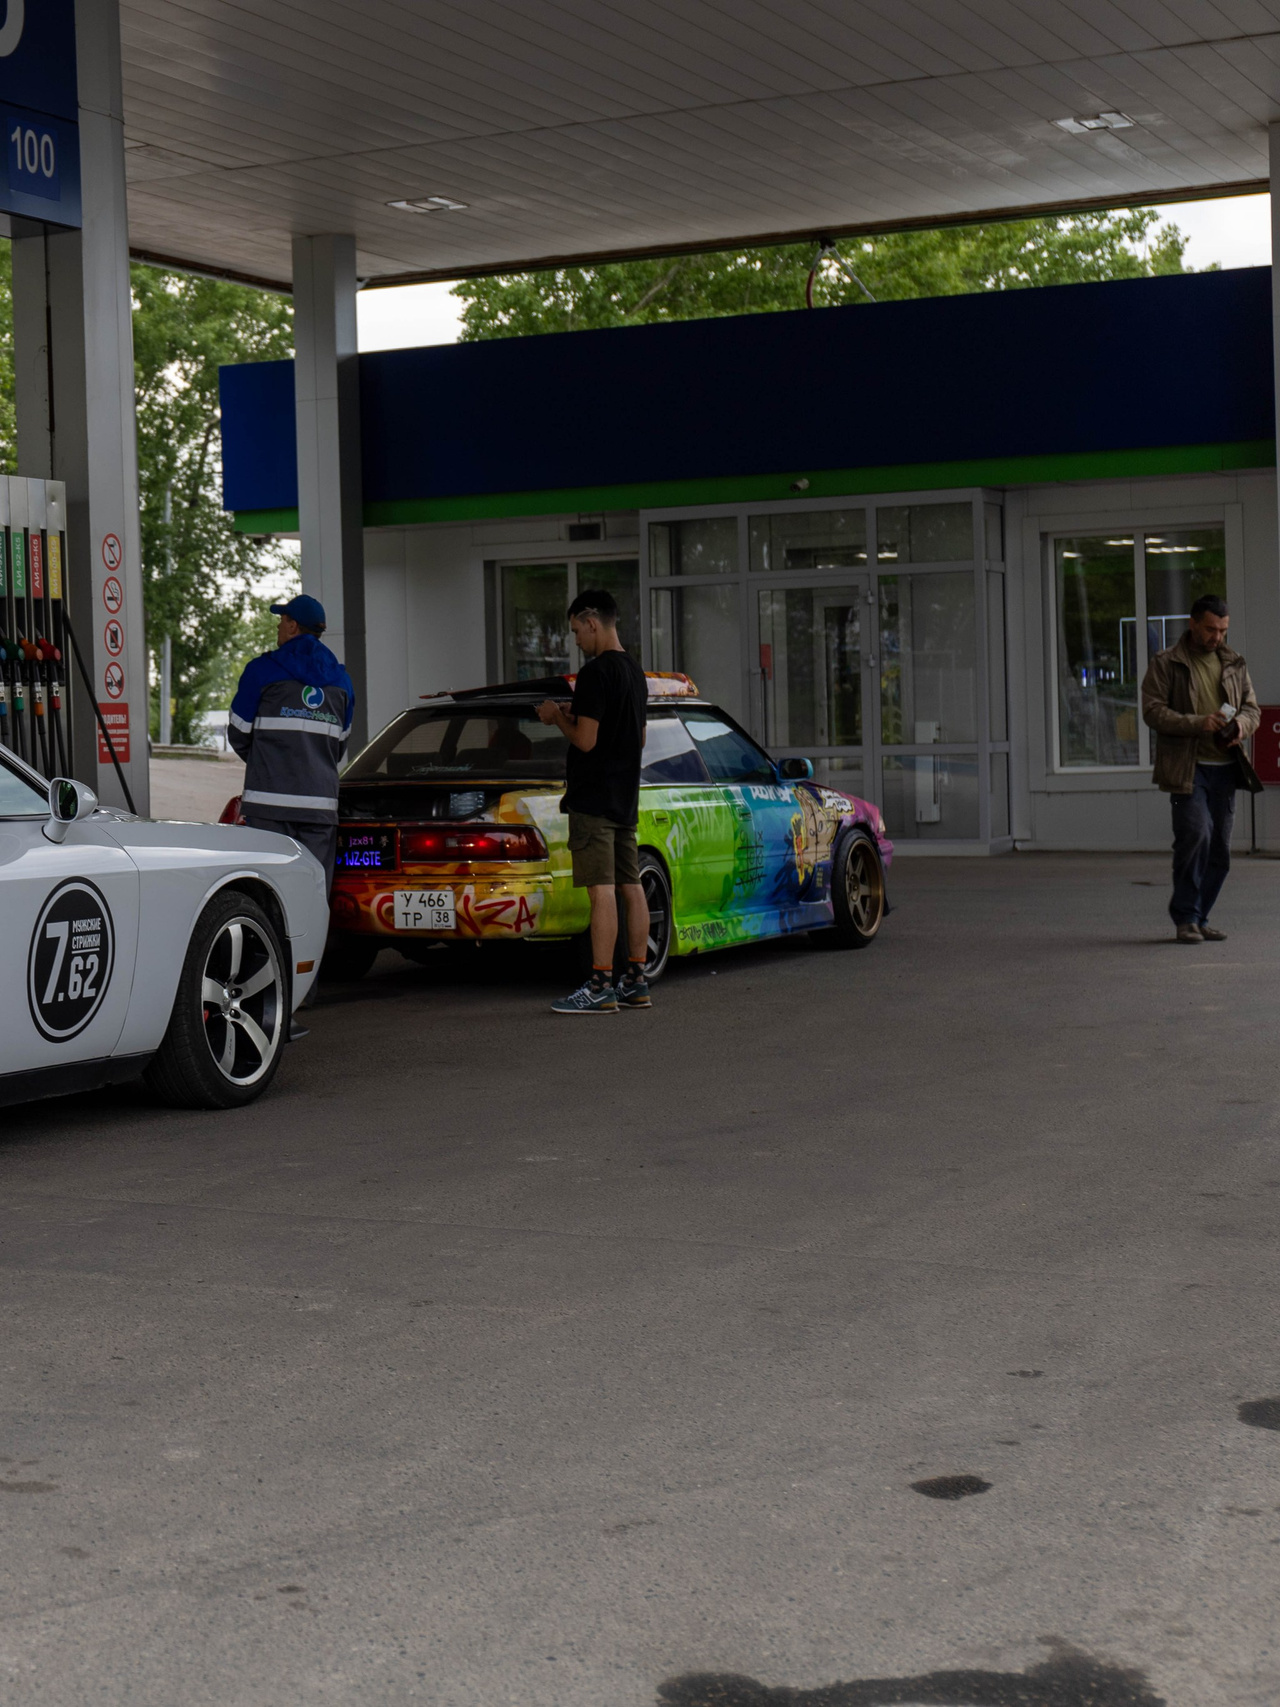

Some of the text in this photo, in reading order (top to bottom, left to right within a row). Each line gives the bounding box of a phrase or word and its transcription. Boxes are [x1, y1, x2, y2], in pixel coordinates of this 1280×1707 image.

[10, 125, 56, 179] 100
[349, 836, 374, 848] jzx81
[344, 850, 382, 866] 1JZ-GTE
[403, 893, 445, 908] У 466
[72, 917, 101, 933] МУЖСКИЕ
[402, 912, 450, 927] ТР 38
[71, 934, 101, 949] СТРИЖКИ
